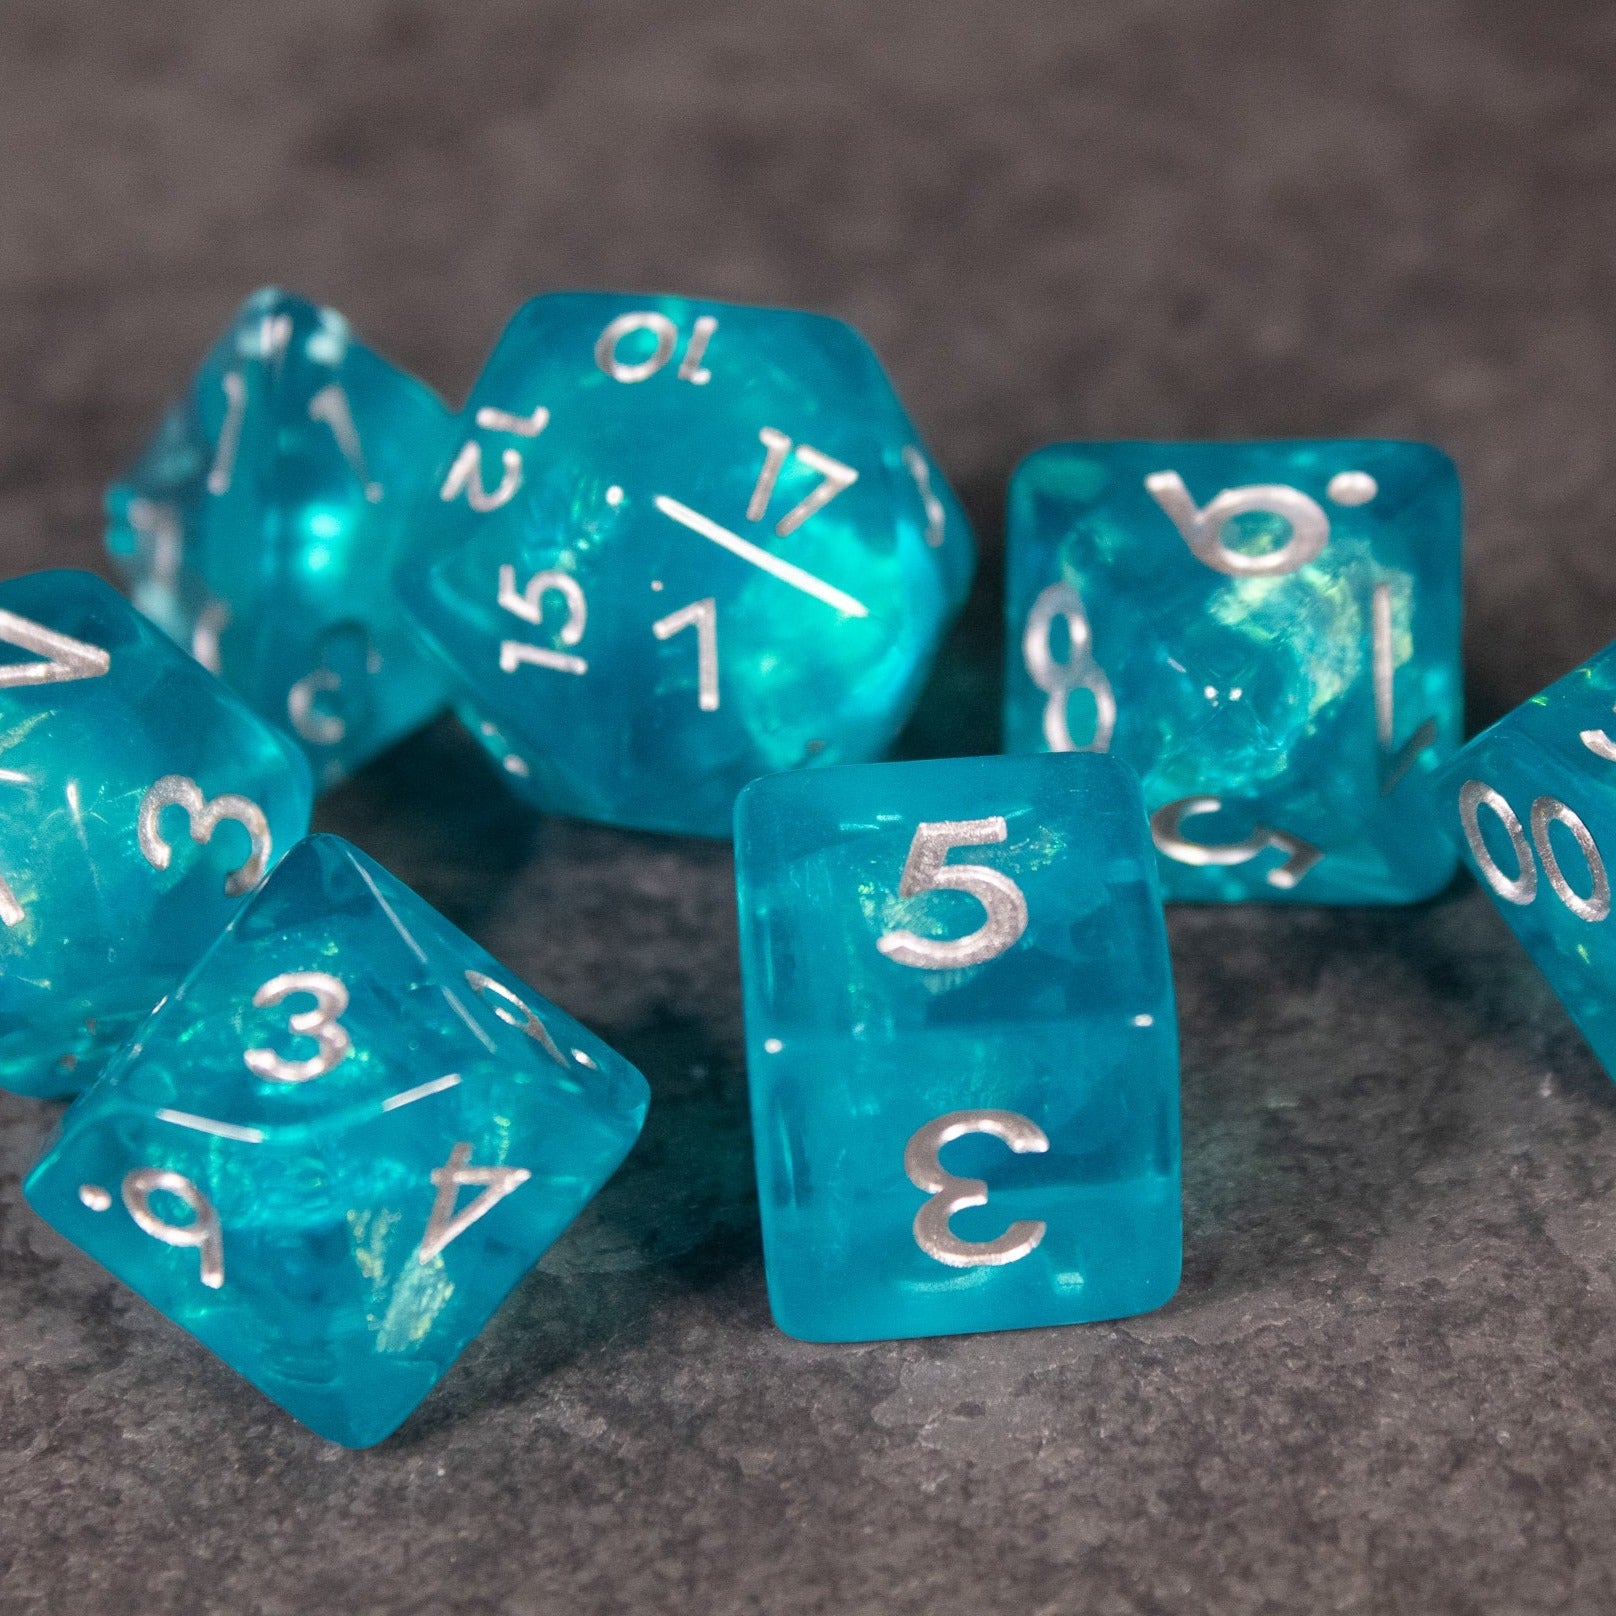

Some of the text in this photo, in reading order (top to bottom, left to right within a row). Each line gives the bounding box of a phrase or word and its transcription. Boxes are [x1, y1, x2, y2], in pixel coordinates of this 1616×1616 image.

[594, 311, 719, 384] 10
[440, 405, 551, 513] 12
[745, 426, 860, 539] 17
[497, 564, 589, 676] 15
[1021, 582, 1118, 755] 8
[137, 774, 272, 898] 3
[875, 815, 1030, 970] 5
[1149, 795, 1325, 889] 5
[1458, 779, 1611, 923] 00
[243, 971, 350, 1083] 3
[418, 1142, 533, 1265] 4
[903, 1109, 1051, 1268] 3
